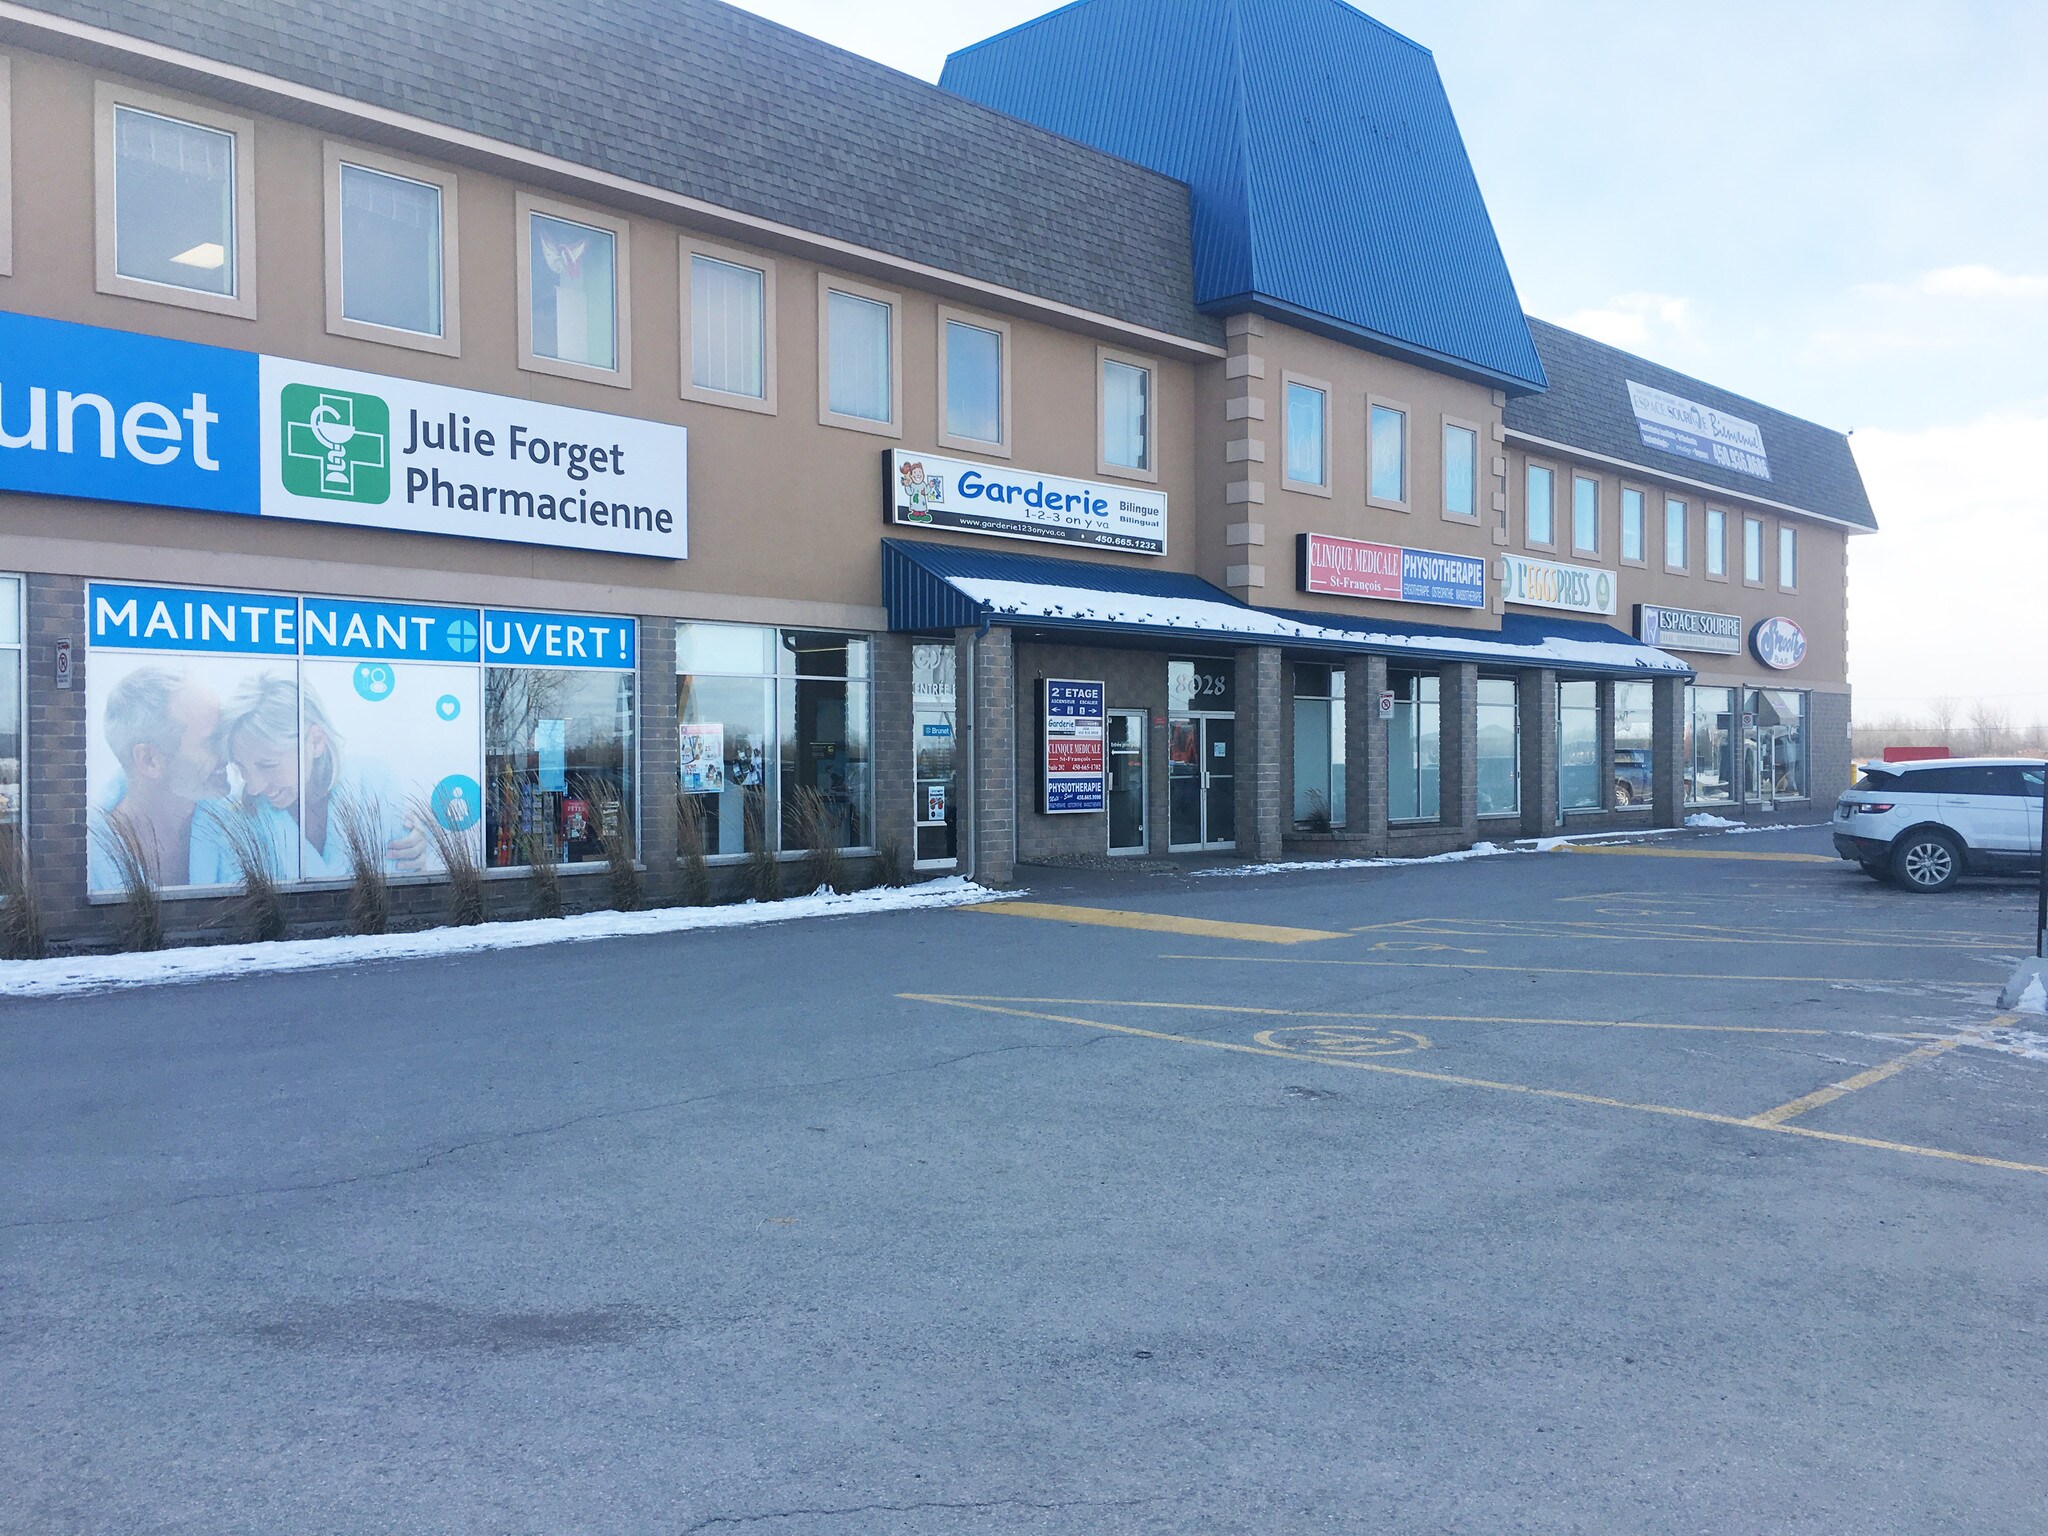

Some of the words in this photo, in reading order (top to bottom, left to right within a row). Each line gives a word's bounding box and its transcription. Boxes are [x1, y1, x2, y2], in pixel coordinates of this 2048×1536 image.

[403, 409, 495, 456] Julie
[510, 425, 625, 481] Forget
[407, 467, 673, 534] Pharmacienne
[958, 471, 1108, 517] Garderie
[1120, 501, 1159, 516] Bilingue
[1025, 509, 1060, 522] 1-2-3
[1066, 517, 1081, 525] on
[1085, 519, 1093, 529] y
[1096, 521, 1109, 529] va
[1120, 516, 1159, 528] Bilingual
[1095, 534, 1156, 550] 450.665.1232
[1311, 543, 1353, 575] CLINIQUE
[1355, 548, 1398, 576] MEDICALE
[1404, 554, 1482, 586] PHYSIOTHERAPIE
[1330, 575, 1381, 593] St-François
[1518, 562, 1590, 607] L'EGGSPRESS
[96, 597, 435, 650] MAINTENANT
[1660, 611, 1697, 632] ESPACE
[1700, 616, 1739, 636] SOURIRE
[914, 681, 949, 695] ENTRÉE
[1066, 688, 1098, 699] ETAGE
[1176, 674, 1226, 696] 8028
[932, 727, 949, 735] Brunet
[1049, 719, 1074, 727] Garderie
[1049, 783, 1101, 792] PHYSIOTHERAPIE
